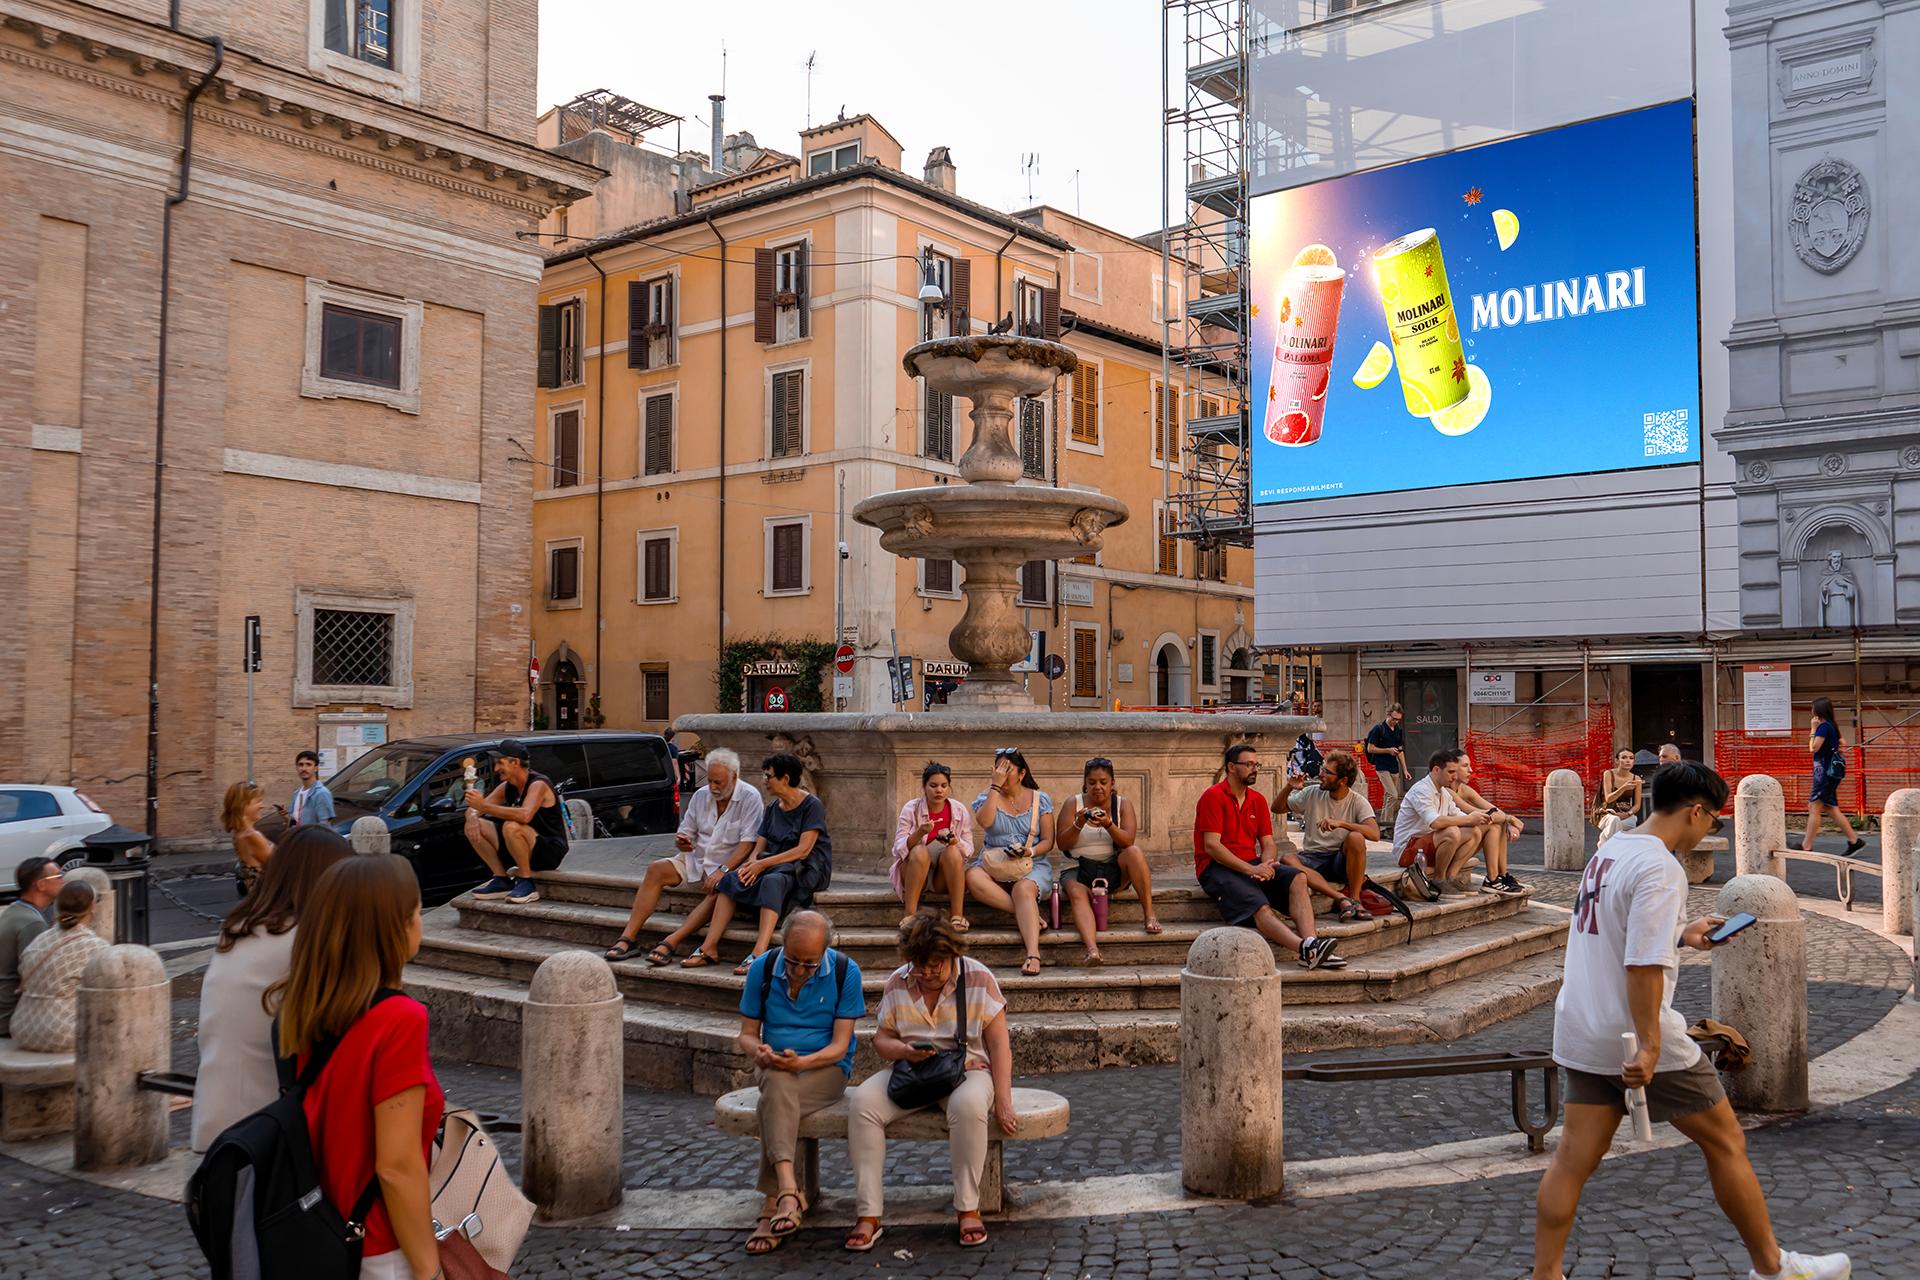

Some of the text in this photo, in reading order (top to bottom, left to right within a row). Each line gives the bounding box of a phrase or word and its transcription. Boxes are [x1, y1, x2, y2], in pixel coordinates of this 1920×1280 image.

[1823, 62, 1858, 77] DOMINI
[1471, 266, 1646, 332] MOLINARI
[1397, 293, 1446, 323] MOLINARI
[1411, 316, 1439, 333] SOUR
[1284, 352, 1320, 363] PALOMA
[1260, 482, 1344, 497] BEVI RESPONSABILMENTE
[743, 662, 799, 675] DARUMA
[926, 663, 971, 675] DARUM
[1416, 715, 1442, 724] SALDI
